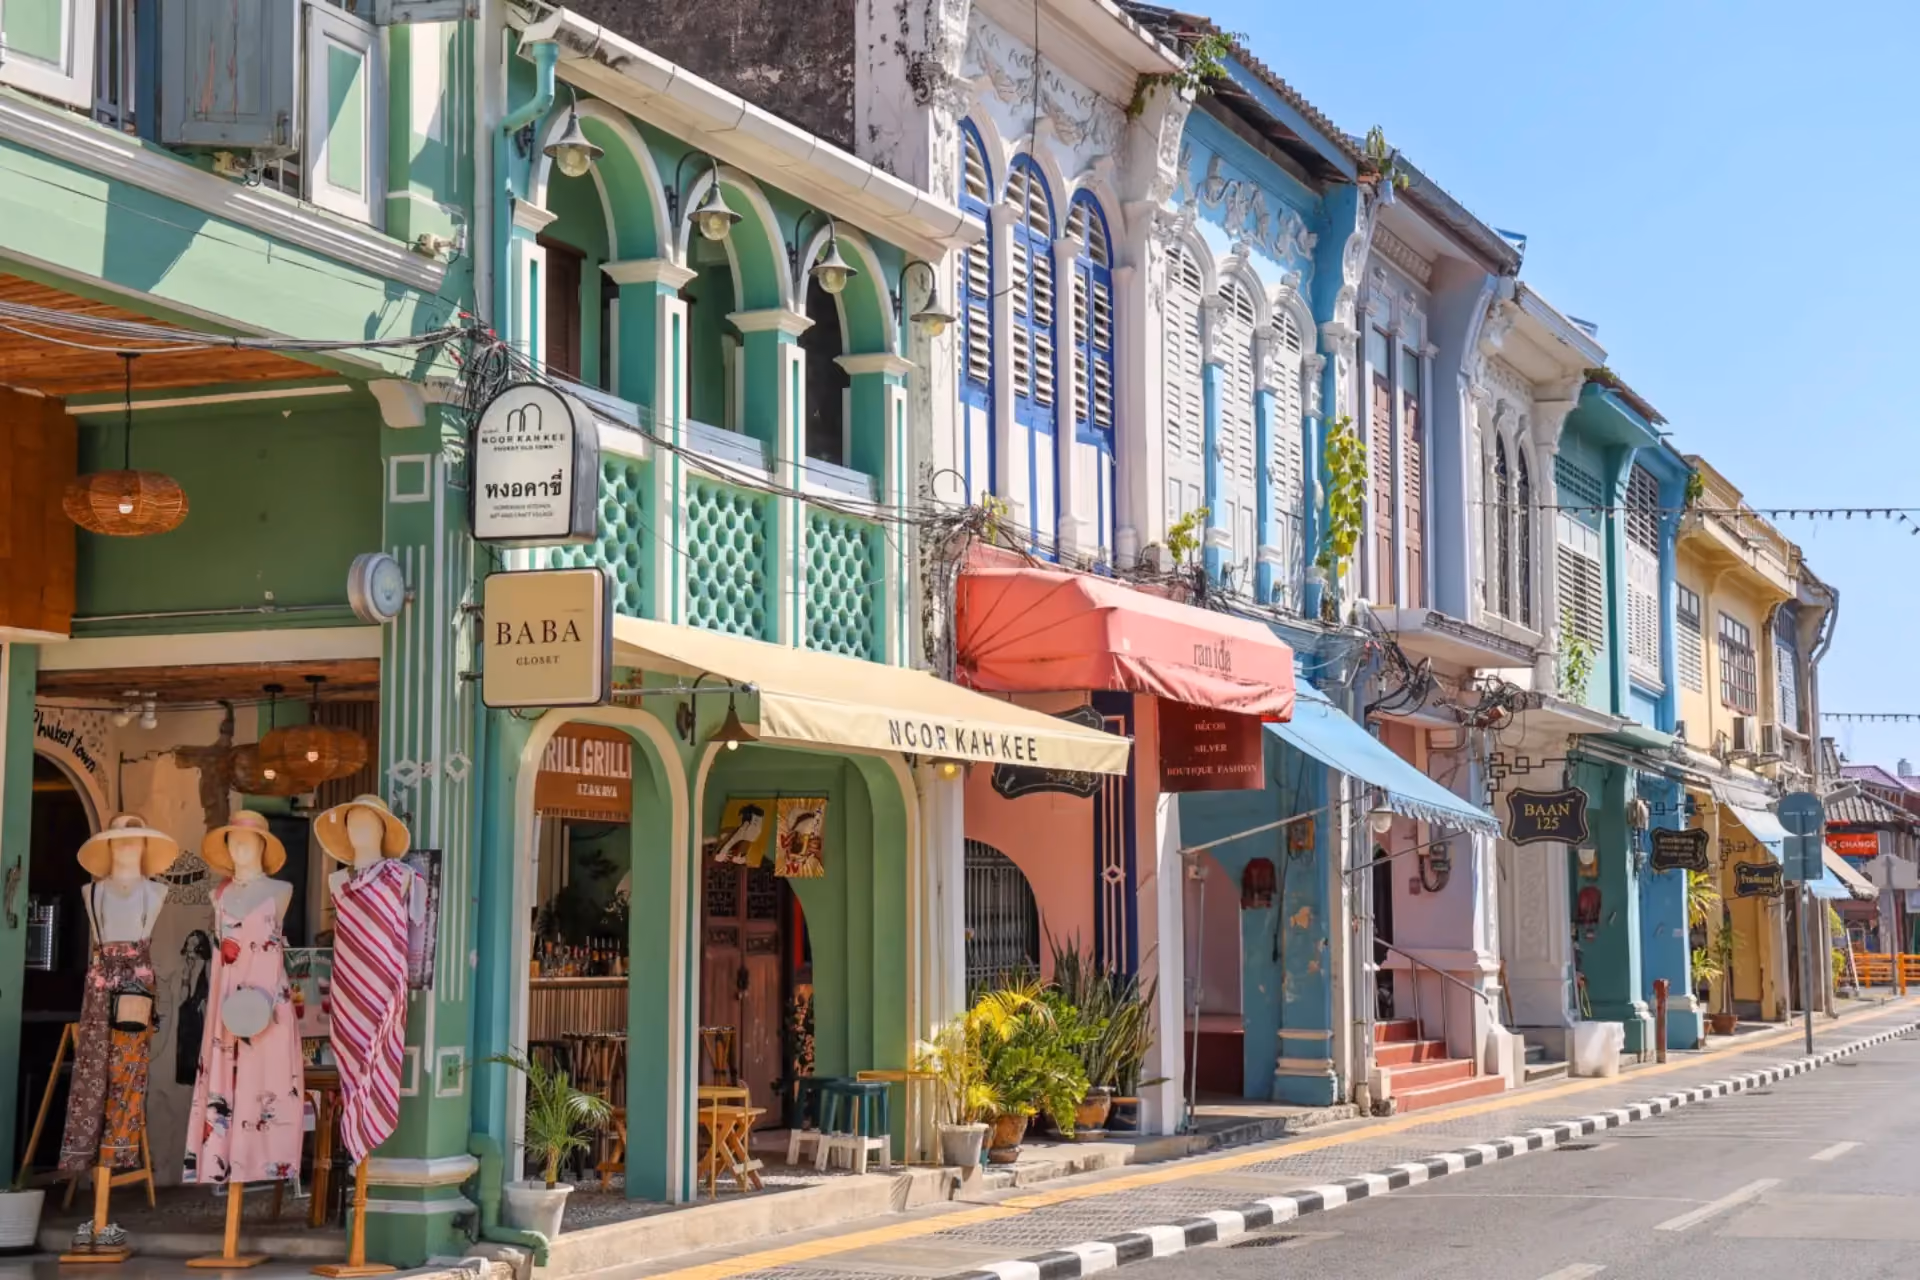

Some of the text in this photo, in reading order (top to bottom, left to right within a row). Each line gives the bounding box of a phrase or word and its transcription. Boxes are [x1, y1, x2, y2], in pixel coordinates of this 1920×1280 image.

[495, 619, 582, 647] BABA
[516, 655, 560, 666] CLOSET
[955, 727, 995, 757] KAH
[1000, 733, 1038, 761] KEE
[1194, 743, 1228, 753] SILVER
[72, 735, 96, 773] town
[582, 739, 629, 779] GRILL
[1167, 764, 1257, 777] BOUTIQUE FASHION
[1523, 803, 1571, 817] BAAN
[1536, 817, 1561, 830] 125
